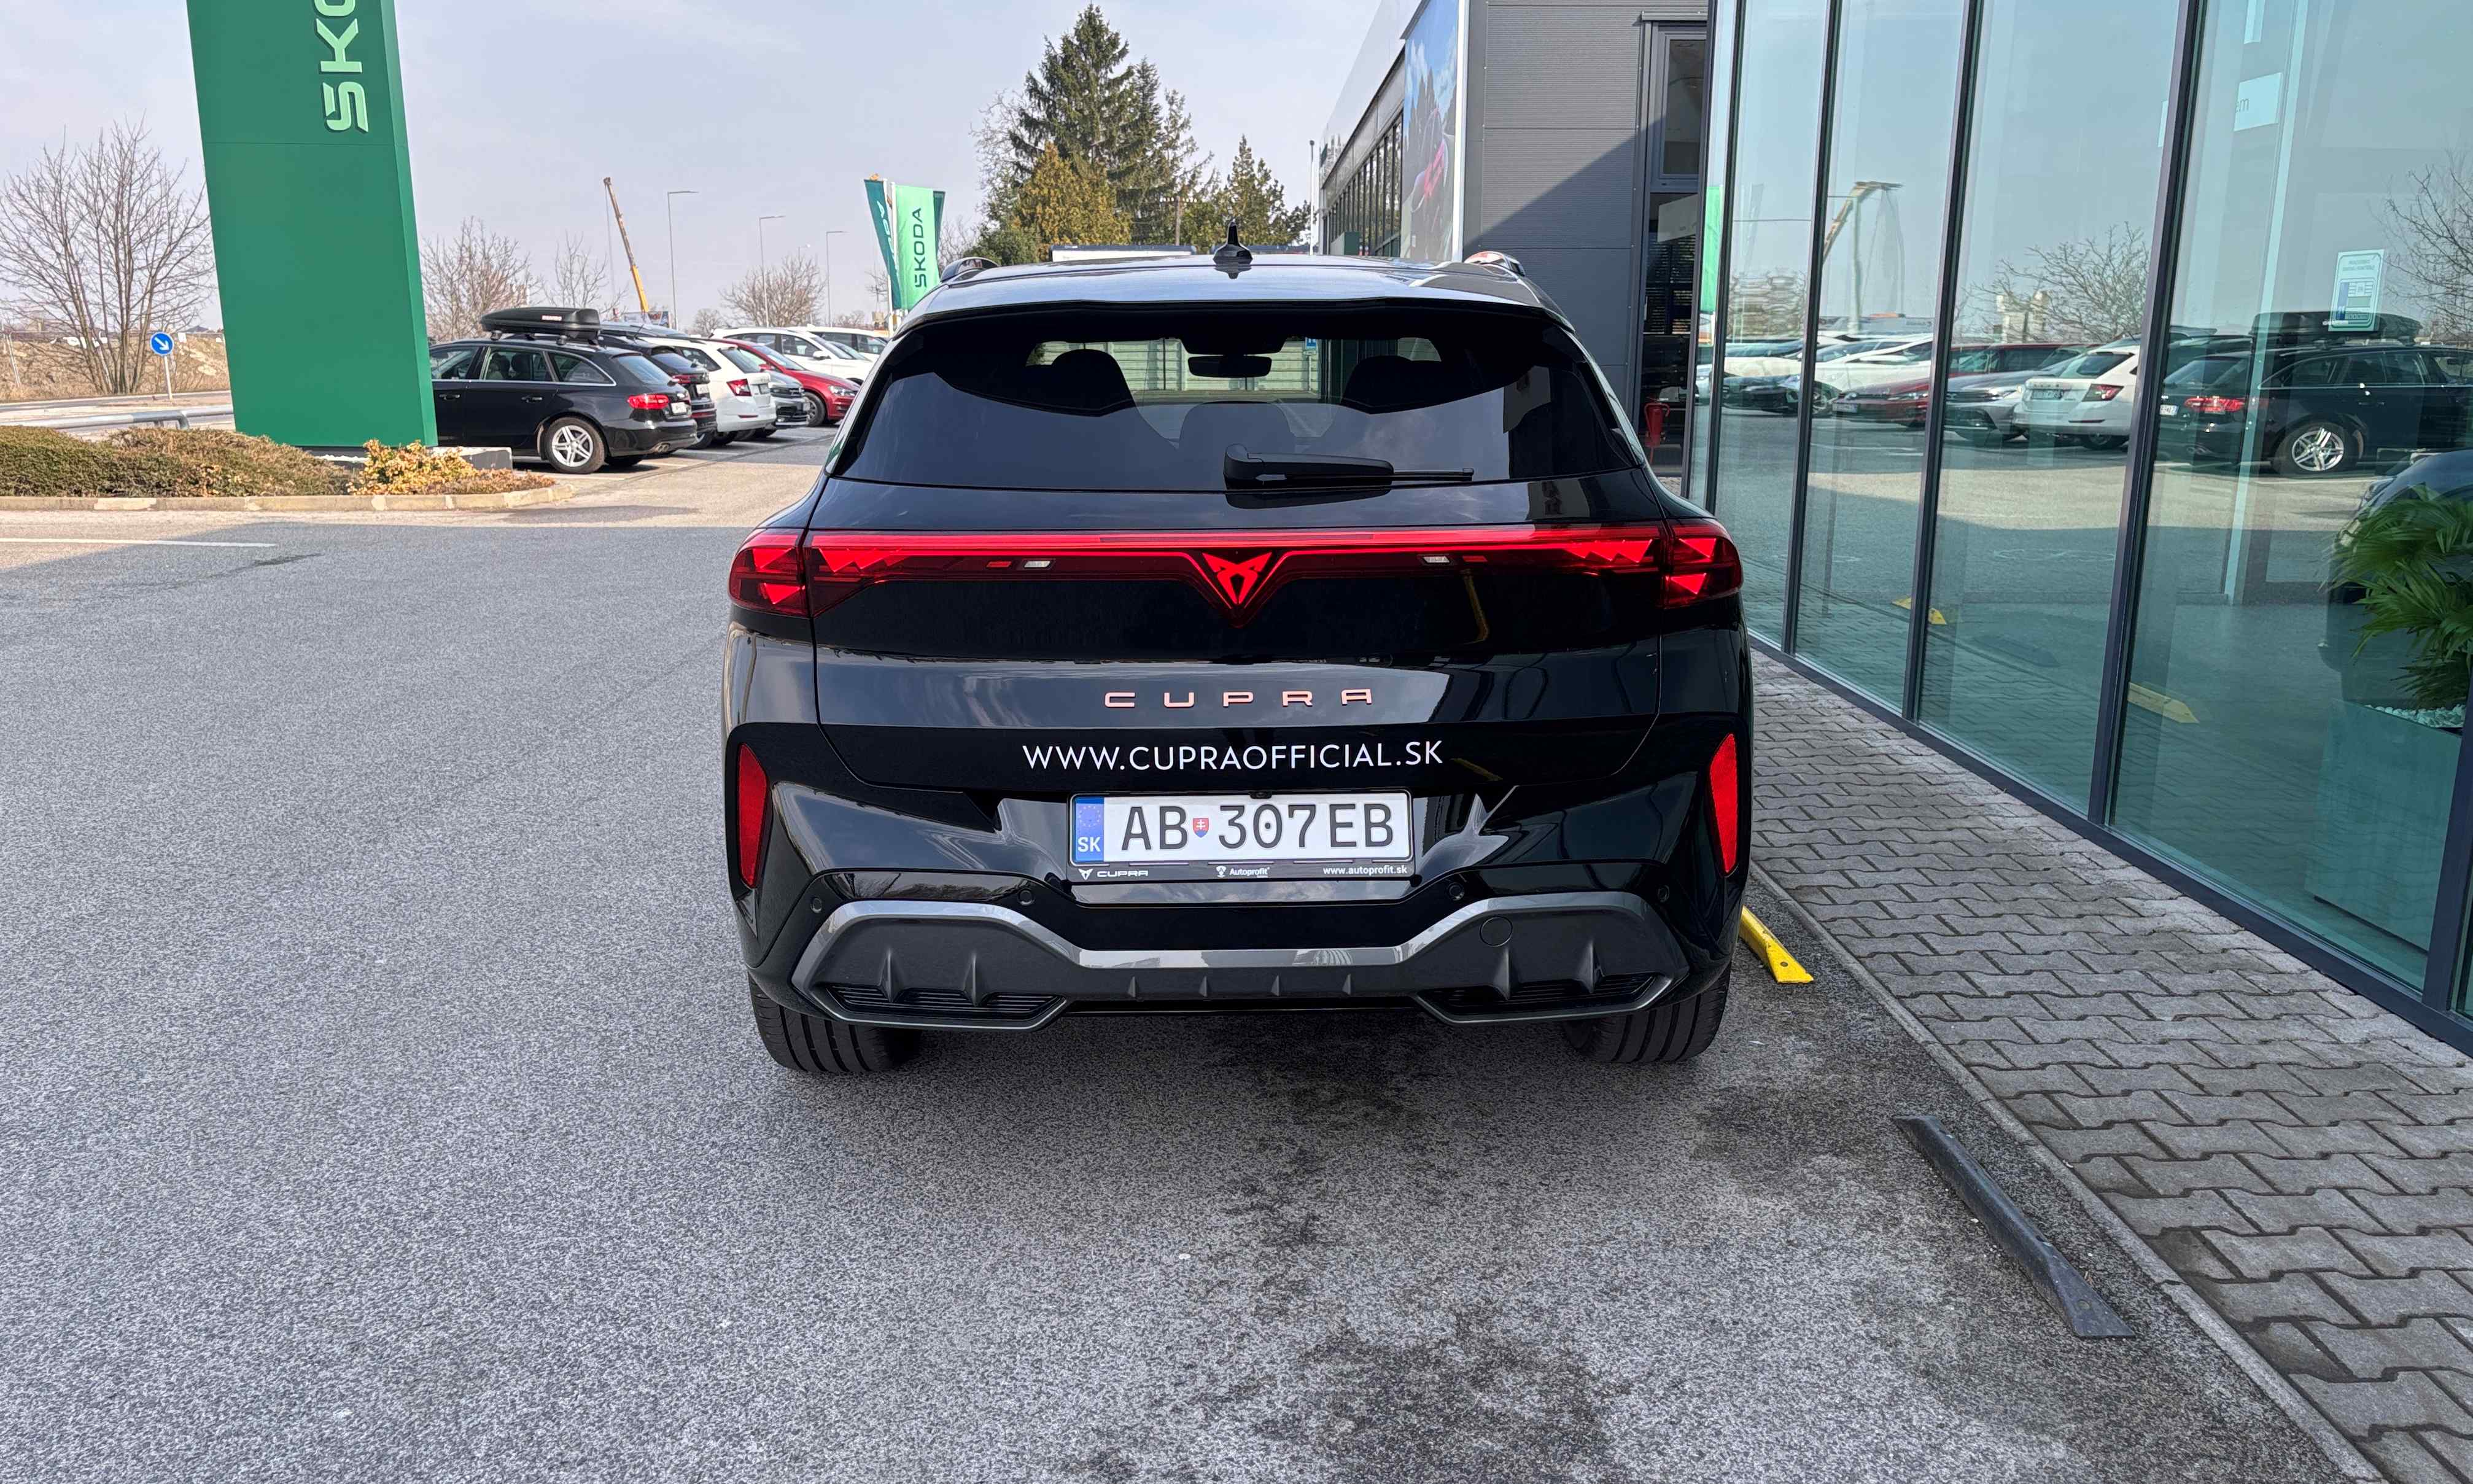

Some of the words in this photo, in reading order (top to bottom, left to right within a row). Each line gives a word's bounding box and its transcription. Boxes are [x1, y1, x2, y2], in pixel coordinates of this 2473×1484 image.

[1105, 688, 1373, 709] CUPRA
[1022, 740, 1443, 771] WWW.CUPRAOFFICIAL.SK
[1122, 806, 1189, 850] AB
[1218, 804, 1394, 849] 307EB
[1077, 836, 1101, 852] SK
[1229, 868, 1268, 877] Autoprofit
[1323, 864, 1408, 876] www.autoprofit.sk
